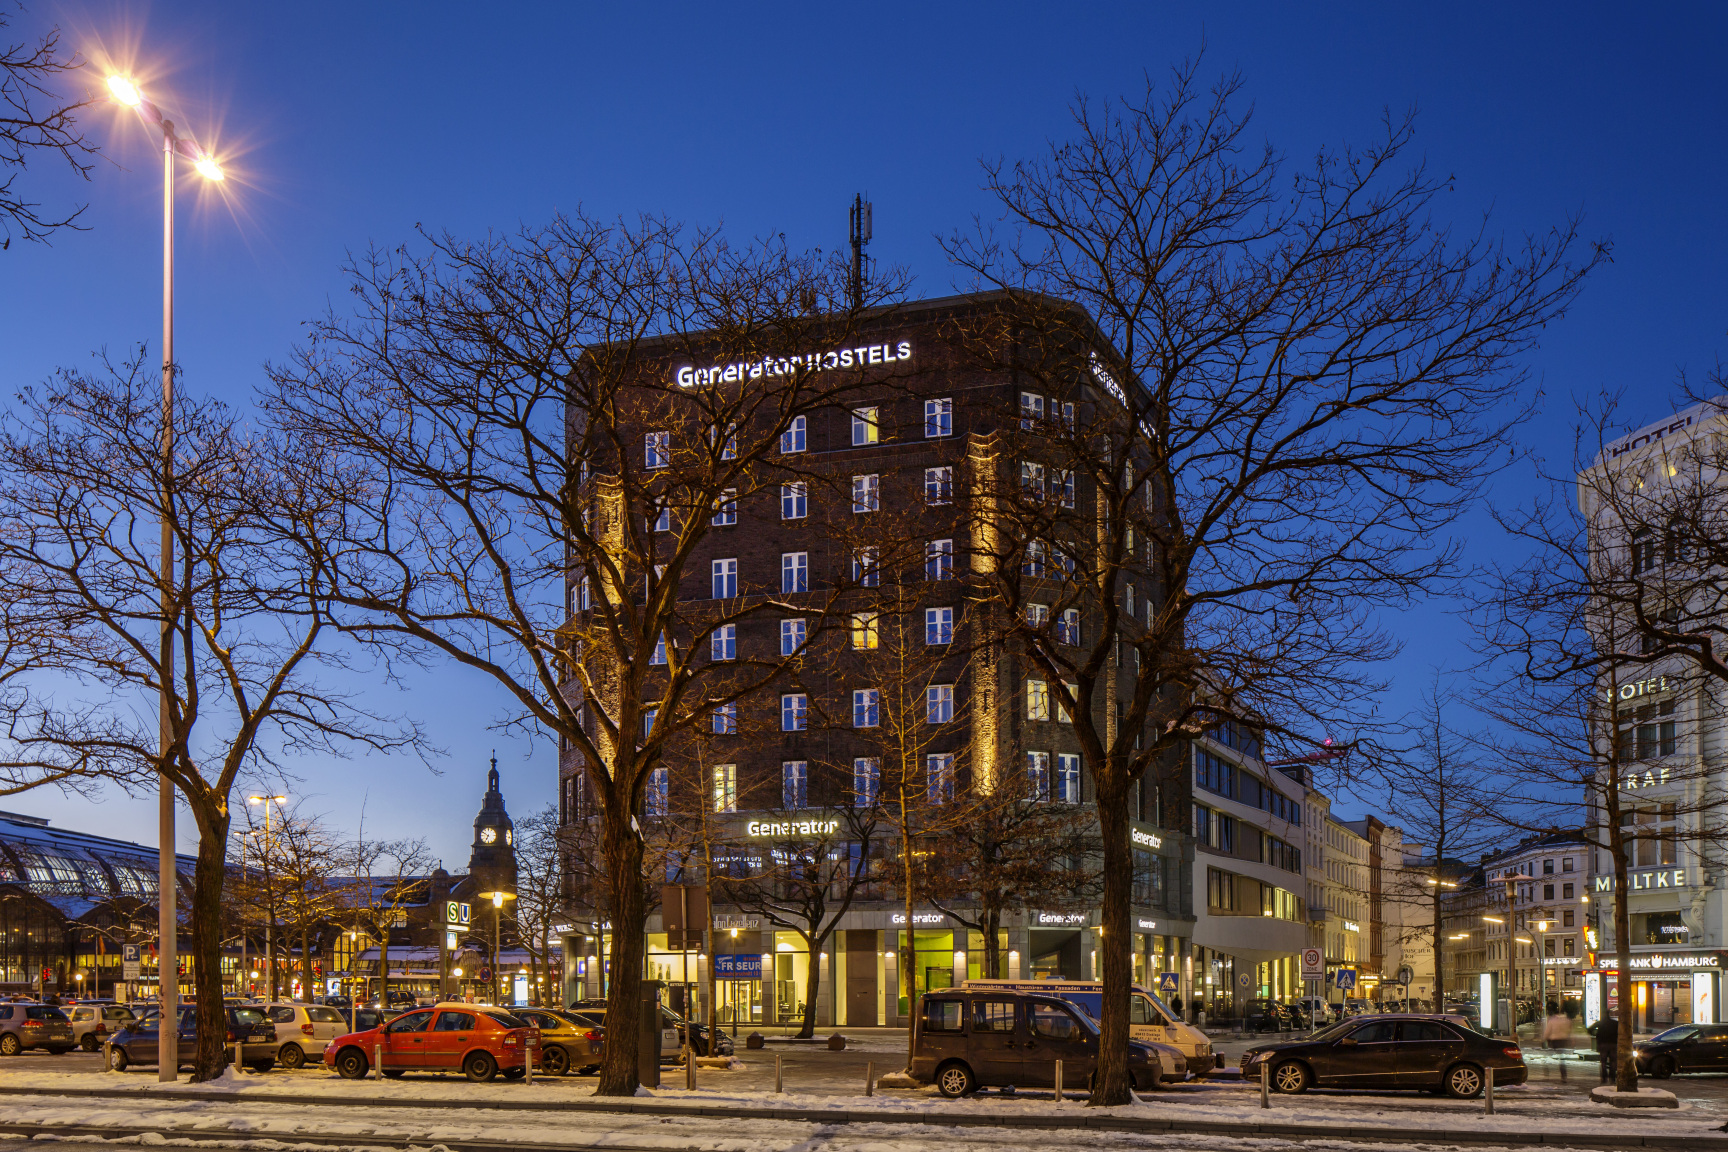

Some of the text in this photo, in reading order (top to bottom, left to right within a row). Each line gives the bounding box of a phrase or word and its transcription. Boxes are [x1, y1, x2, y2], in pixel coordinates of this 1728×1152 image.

[677, 342, 911, 388] Generator HOSTELS
[1606, 768, 1670, 790] RAF
[747, 820, 838, 837] Generator
[1132, 827, 1162, 849] Generator
[1595, 869, 1685, 892] MLTKE
[449, 904, 469, 922] S U
[892, 913, 944, 924] Geerator
[1039, 913, 1085, 924] Generator
[126, 946, 135, 960] P
[1307, 953, 1317, 962] 30
[721, 961, 761, 971] FRSEUR
[1599, 956, 1718, 969] SPIEANK HAMBURG
